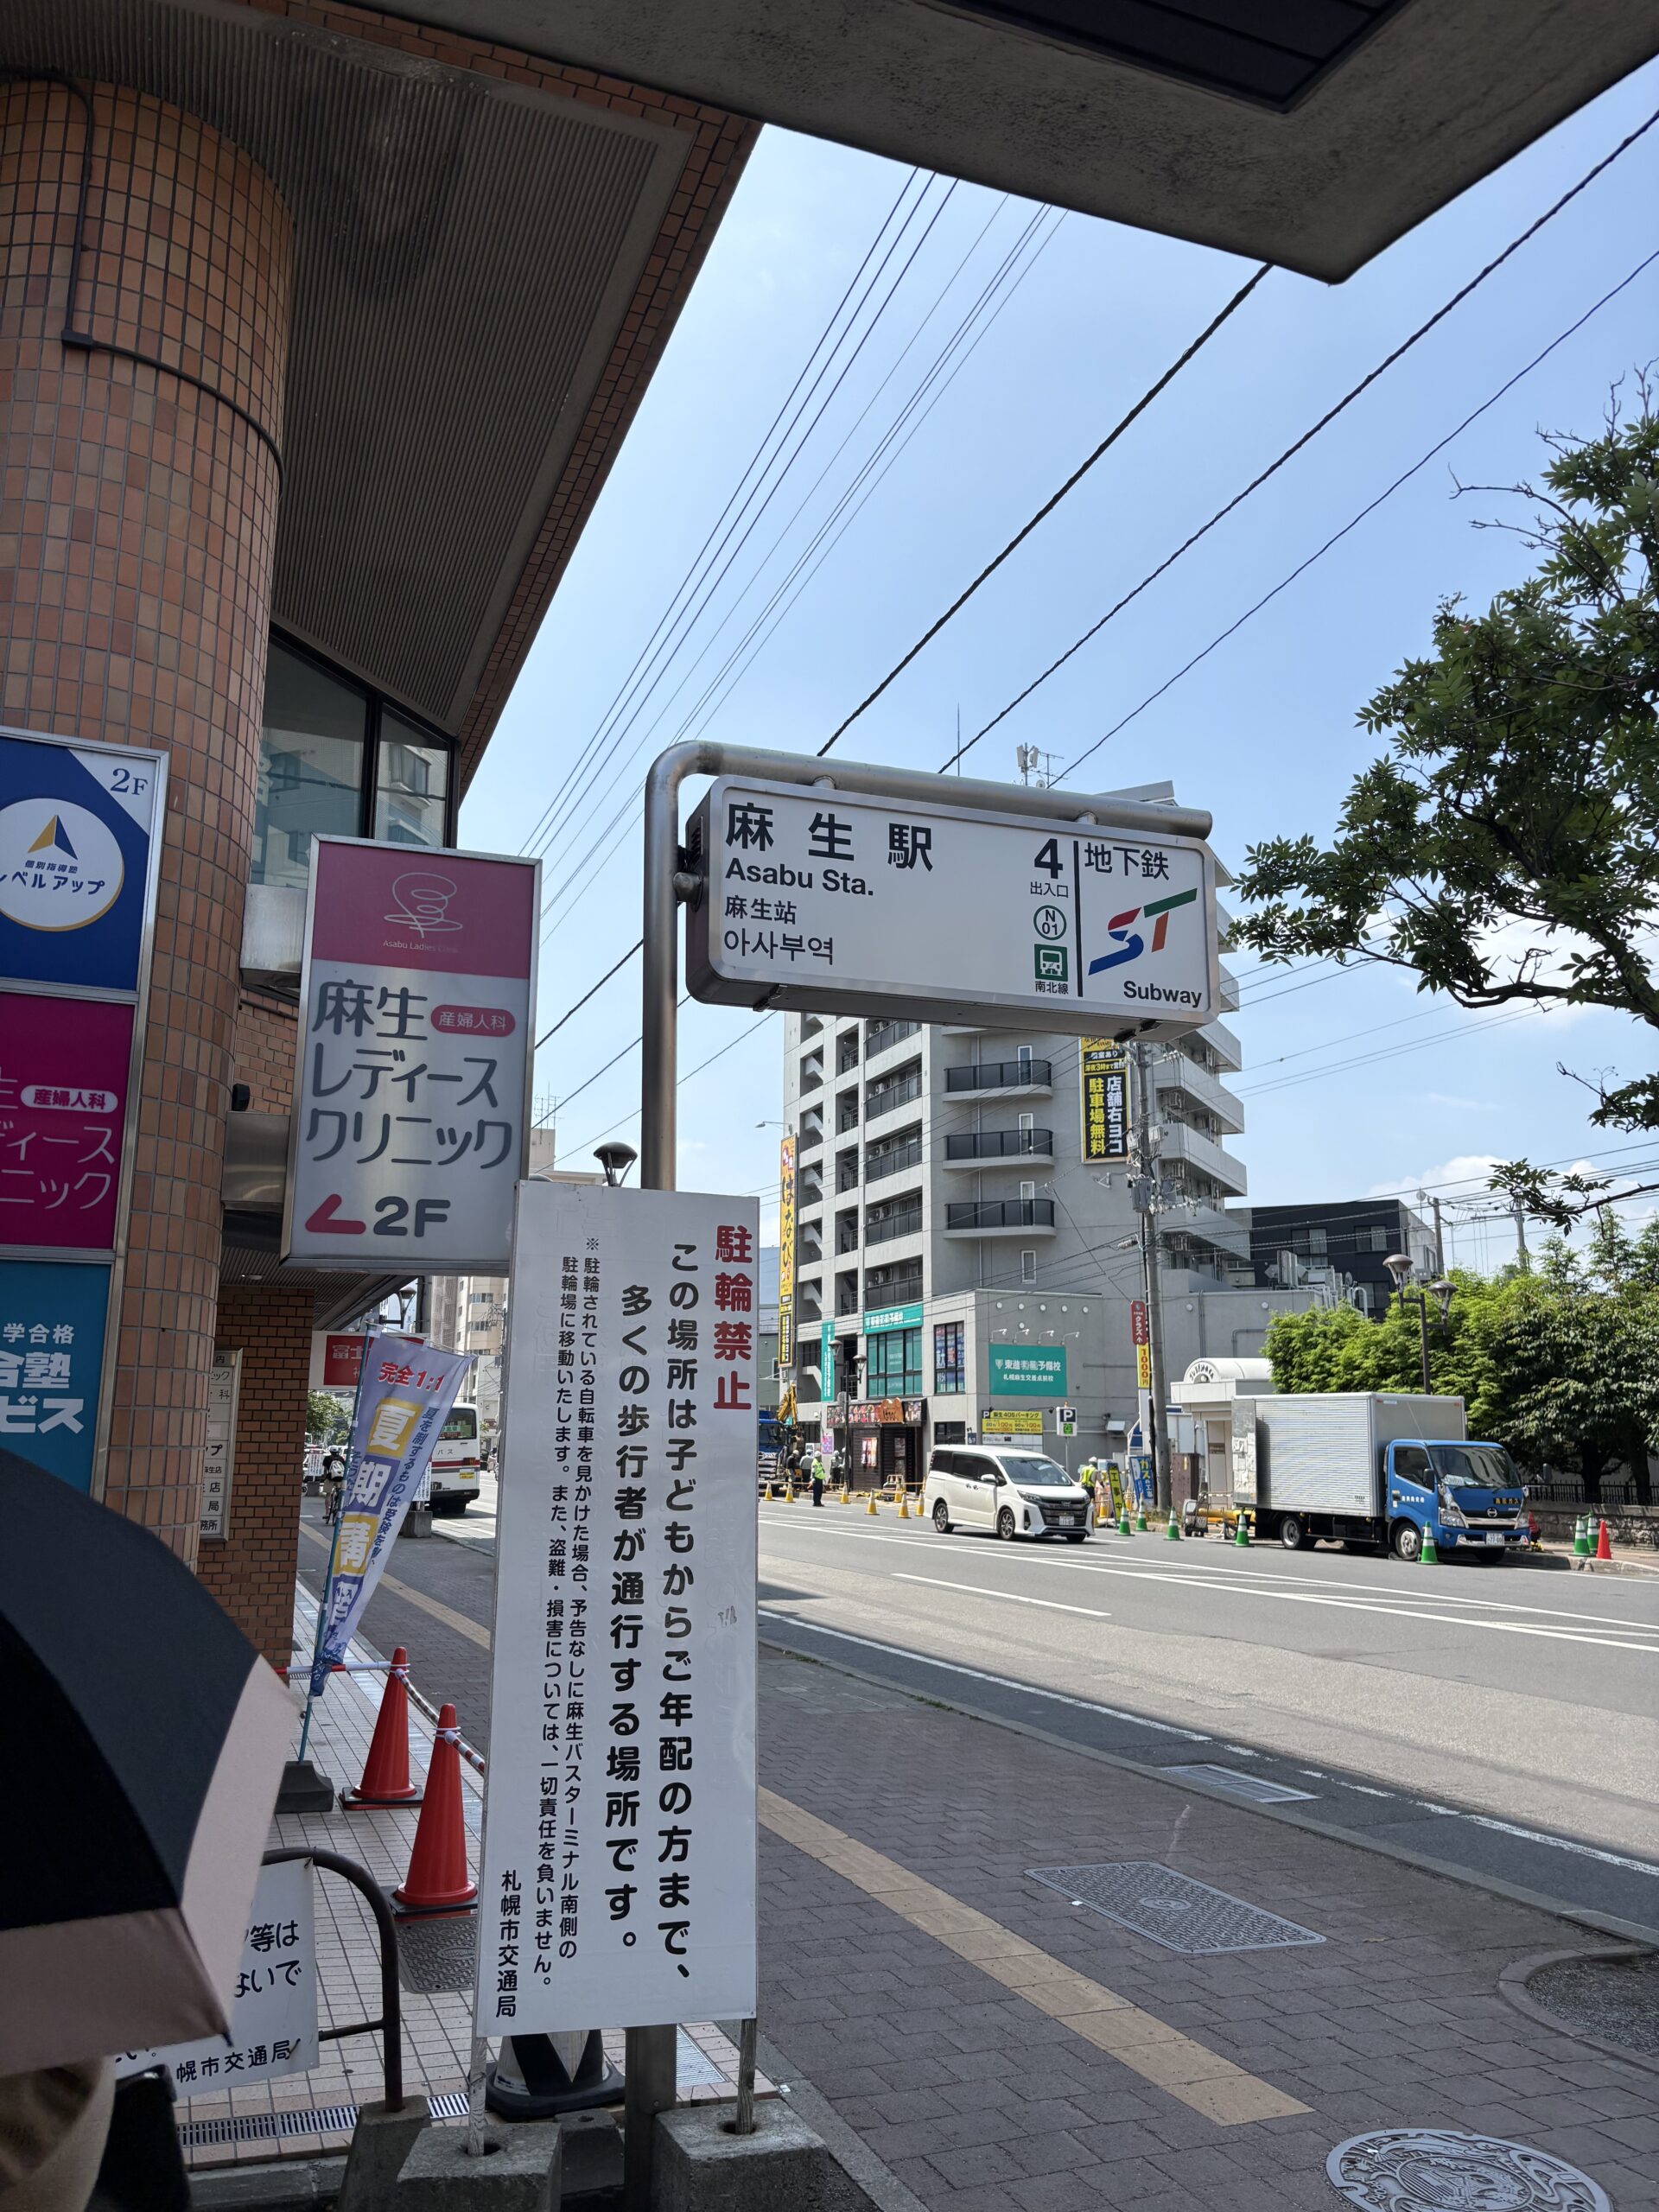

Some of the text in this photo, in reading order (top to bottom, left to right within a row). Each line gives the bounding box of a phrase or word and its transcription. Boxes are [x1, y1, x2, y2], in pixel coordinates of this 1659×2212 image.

[111, 767, 149, 796] 2F
[725, 802, 933, 872] 麻生駅
[24, 860, 79, 874] 個別指導塾
[725, 857, 874, 896] Asabu Sta.
[1033, 838, 1064, 880] 4
[1084, 842, 1170, 881] 地下鉄
[1030, 880, 1069, 899] 出入口
[724, 894, 797, 925] 麻生站
[1041, 922, 1058, 936] 01
[1045, 909, 1056, 922] N
[383, 938, 408, 949] Asabu
[724, 927, 834, 966] 아사부역
[1034, 981, 1069, 995] 南北線
[1123, 980, 1203, 1009] Subway
[312, 979, 428, 1041] 麻生
[438, 1011, 507, 1031] 産婦人科
[312, 1042, 499, 1109] レディース
[33, 1088, 107, 1110] 産婦人科
[1089, 1077, 1106, 1155] 駐車場無料
[1106, 1075, 1123, 1154] 店舗右ヨコ
[306, 1108, 512, 1169] クリニック
[372, 1195, 452, 1238] 2F
[3, 1322, 74, 1344] 学合格
[713, 1224, 753, 1411] 駐輪禁止
[377, 1362, 446, 1393] 完全1:1
[1063, 1409, 1073, 1422] P
[605, 1284, 652, 1948] 多くの歩行者が通行する場所です。
[658, 1243, 700, 1979] この場所は子どもからご年配の方まで、
[244, 1920, 300, 1953] 等は
[495, 1869, 522, 2018] 札幌市交通局
[176, 2039, 291, 2083] 幌市交通局
